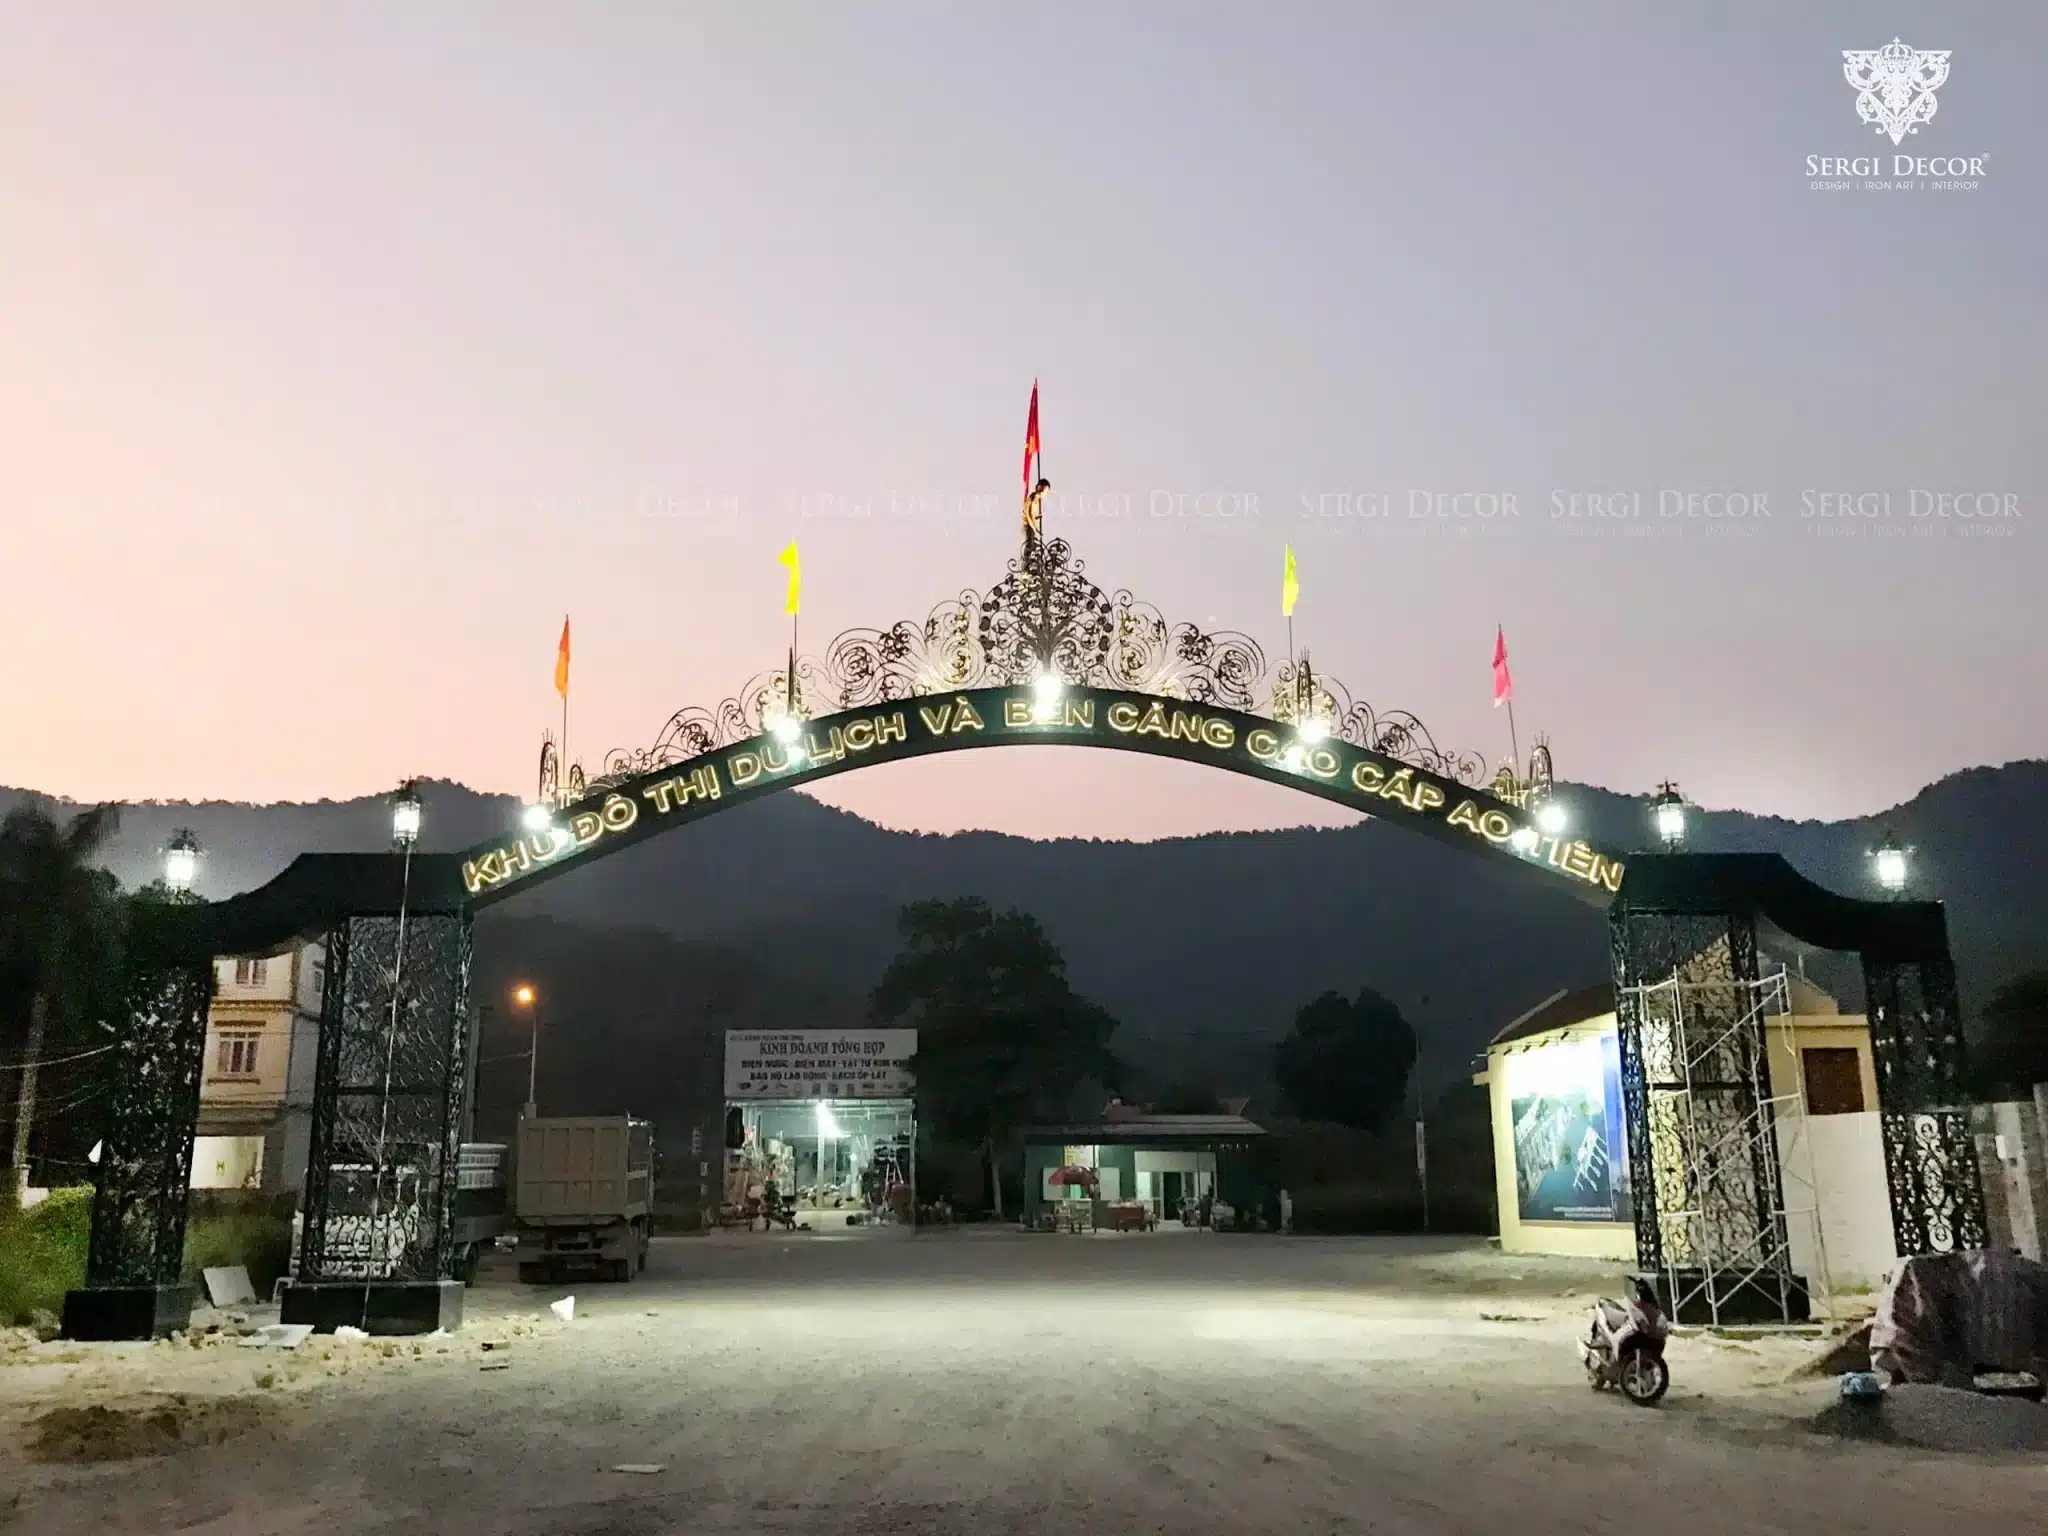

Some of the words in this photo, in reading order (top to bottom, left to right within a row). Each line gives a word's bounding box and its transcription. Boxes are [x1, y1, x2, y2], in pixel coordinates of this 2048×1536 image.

[462, 832, 558, 893] KHU
[570, 792, 638, 846] ĐÔ
[644, 764, 721, 814] THỊ
[728, 743, 790, 786] DU
[804, 711, 906, 762] LỊCH
[920, 696, 984, 736] VÀ
[1352, 761, 1446, 811] CẤP
[1447, 799, 1513, 844] AO
[760, 1042, 788, 1054] KINH
[790, 1042, 829, 1054] DOANH
